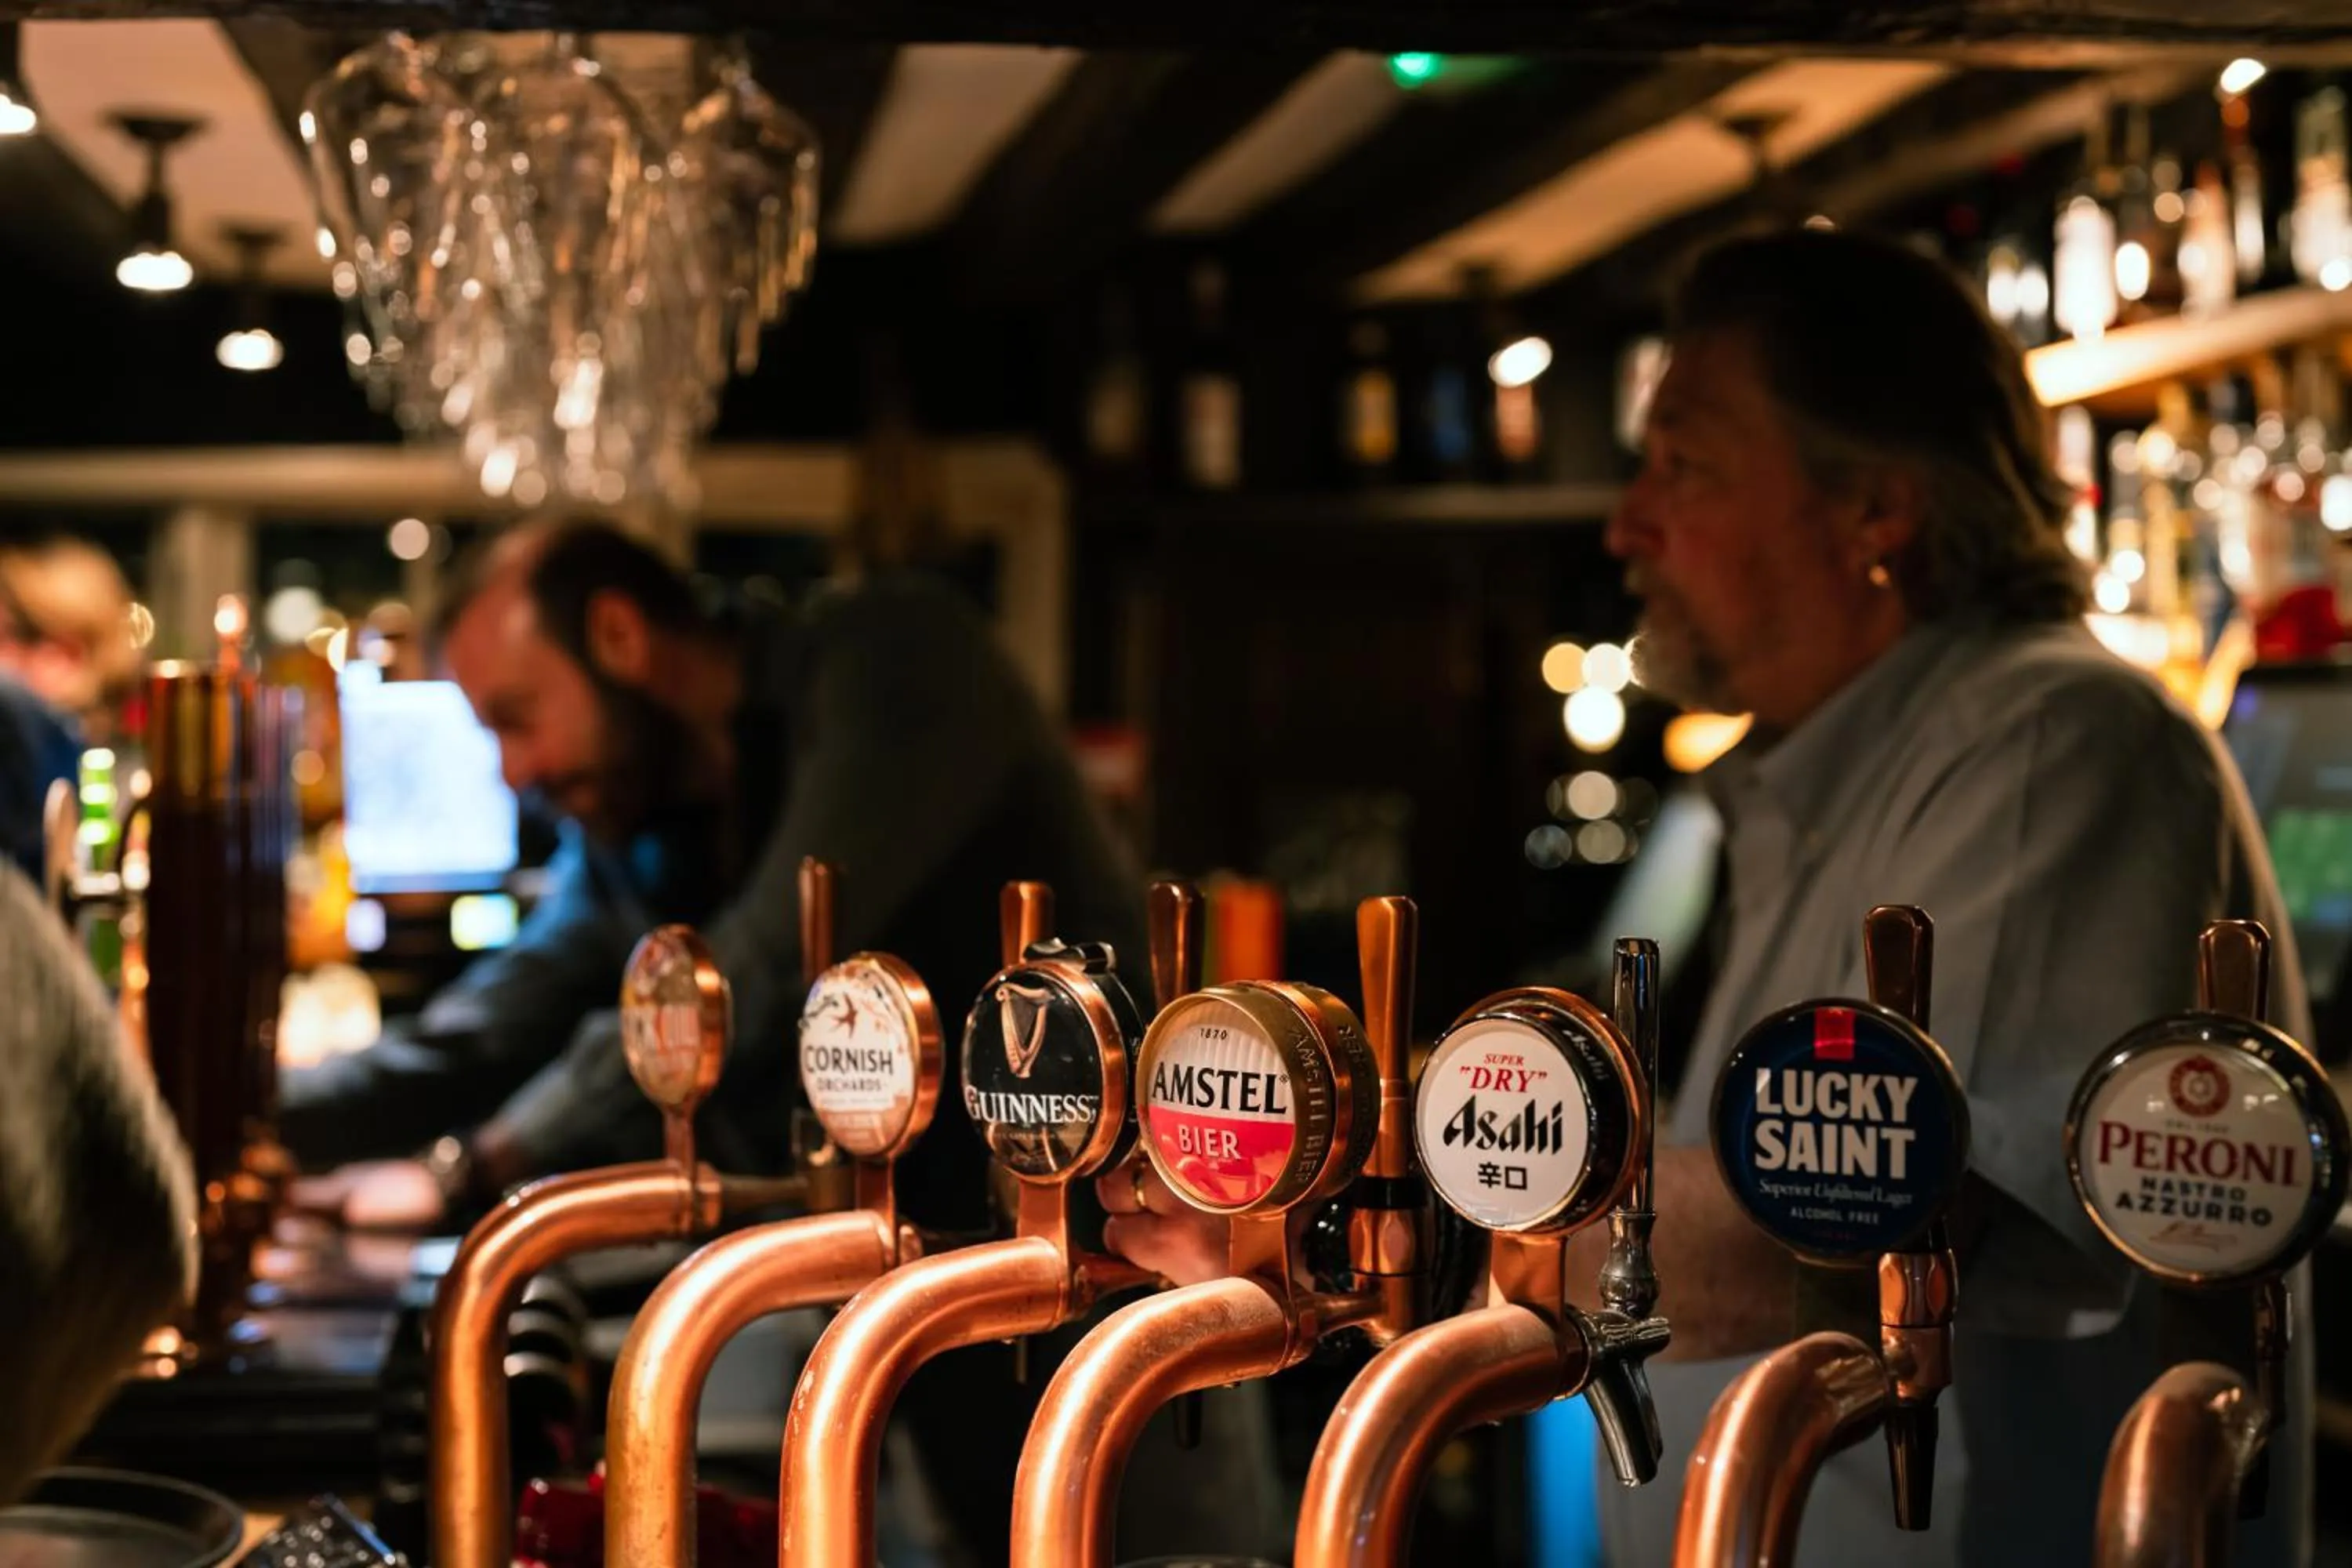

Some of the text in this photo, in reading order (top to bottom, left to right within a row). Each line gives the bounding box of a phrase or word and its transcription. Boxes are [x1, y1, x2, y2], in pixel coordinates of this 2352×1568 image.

[804, 1044, 893, 1075] CORNISH
[1484, 1053, 1524, 1065] SUPER
[817, 1076, 882, 1092] ORCHARDS
[1152, 1062, 1287, 1114] AMSTEL
[1755, 1067, 1918, 1123] LUCKY
[964, 1084, 1092, 1123] GUINNESS
[1178, 1123, 1241, 1160] BIER
[1443, 1094, 1563, 1155] Asahi
[1755, 1119, 1916, 1179] SAINT
[2097, 1120, 2297, 1187] PERONI
[1477, 1161, 1528, 1191] 辛口
[2140, 1176, 2247, 1202] NASTRO
[1790, 1207, 1880, 1226] ALCOHOL FREE
[2115, 1192, 2273, 1227] AZZURRO
